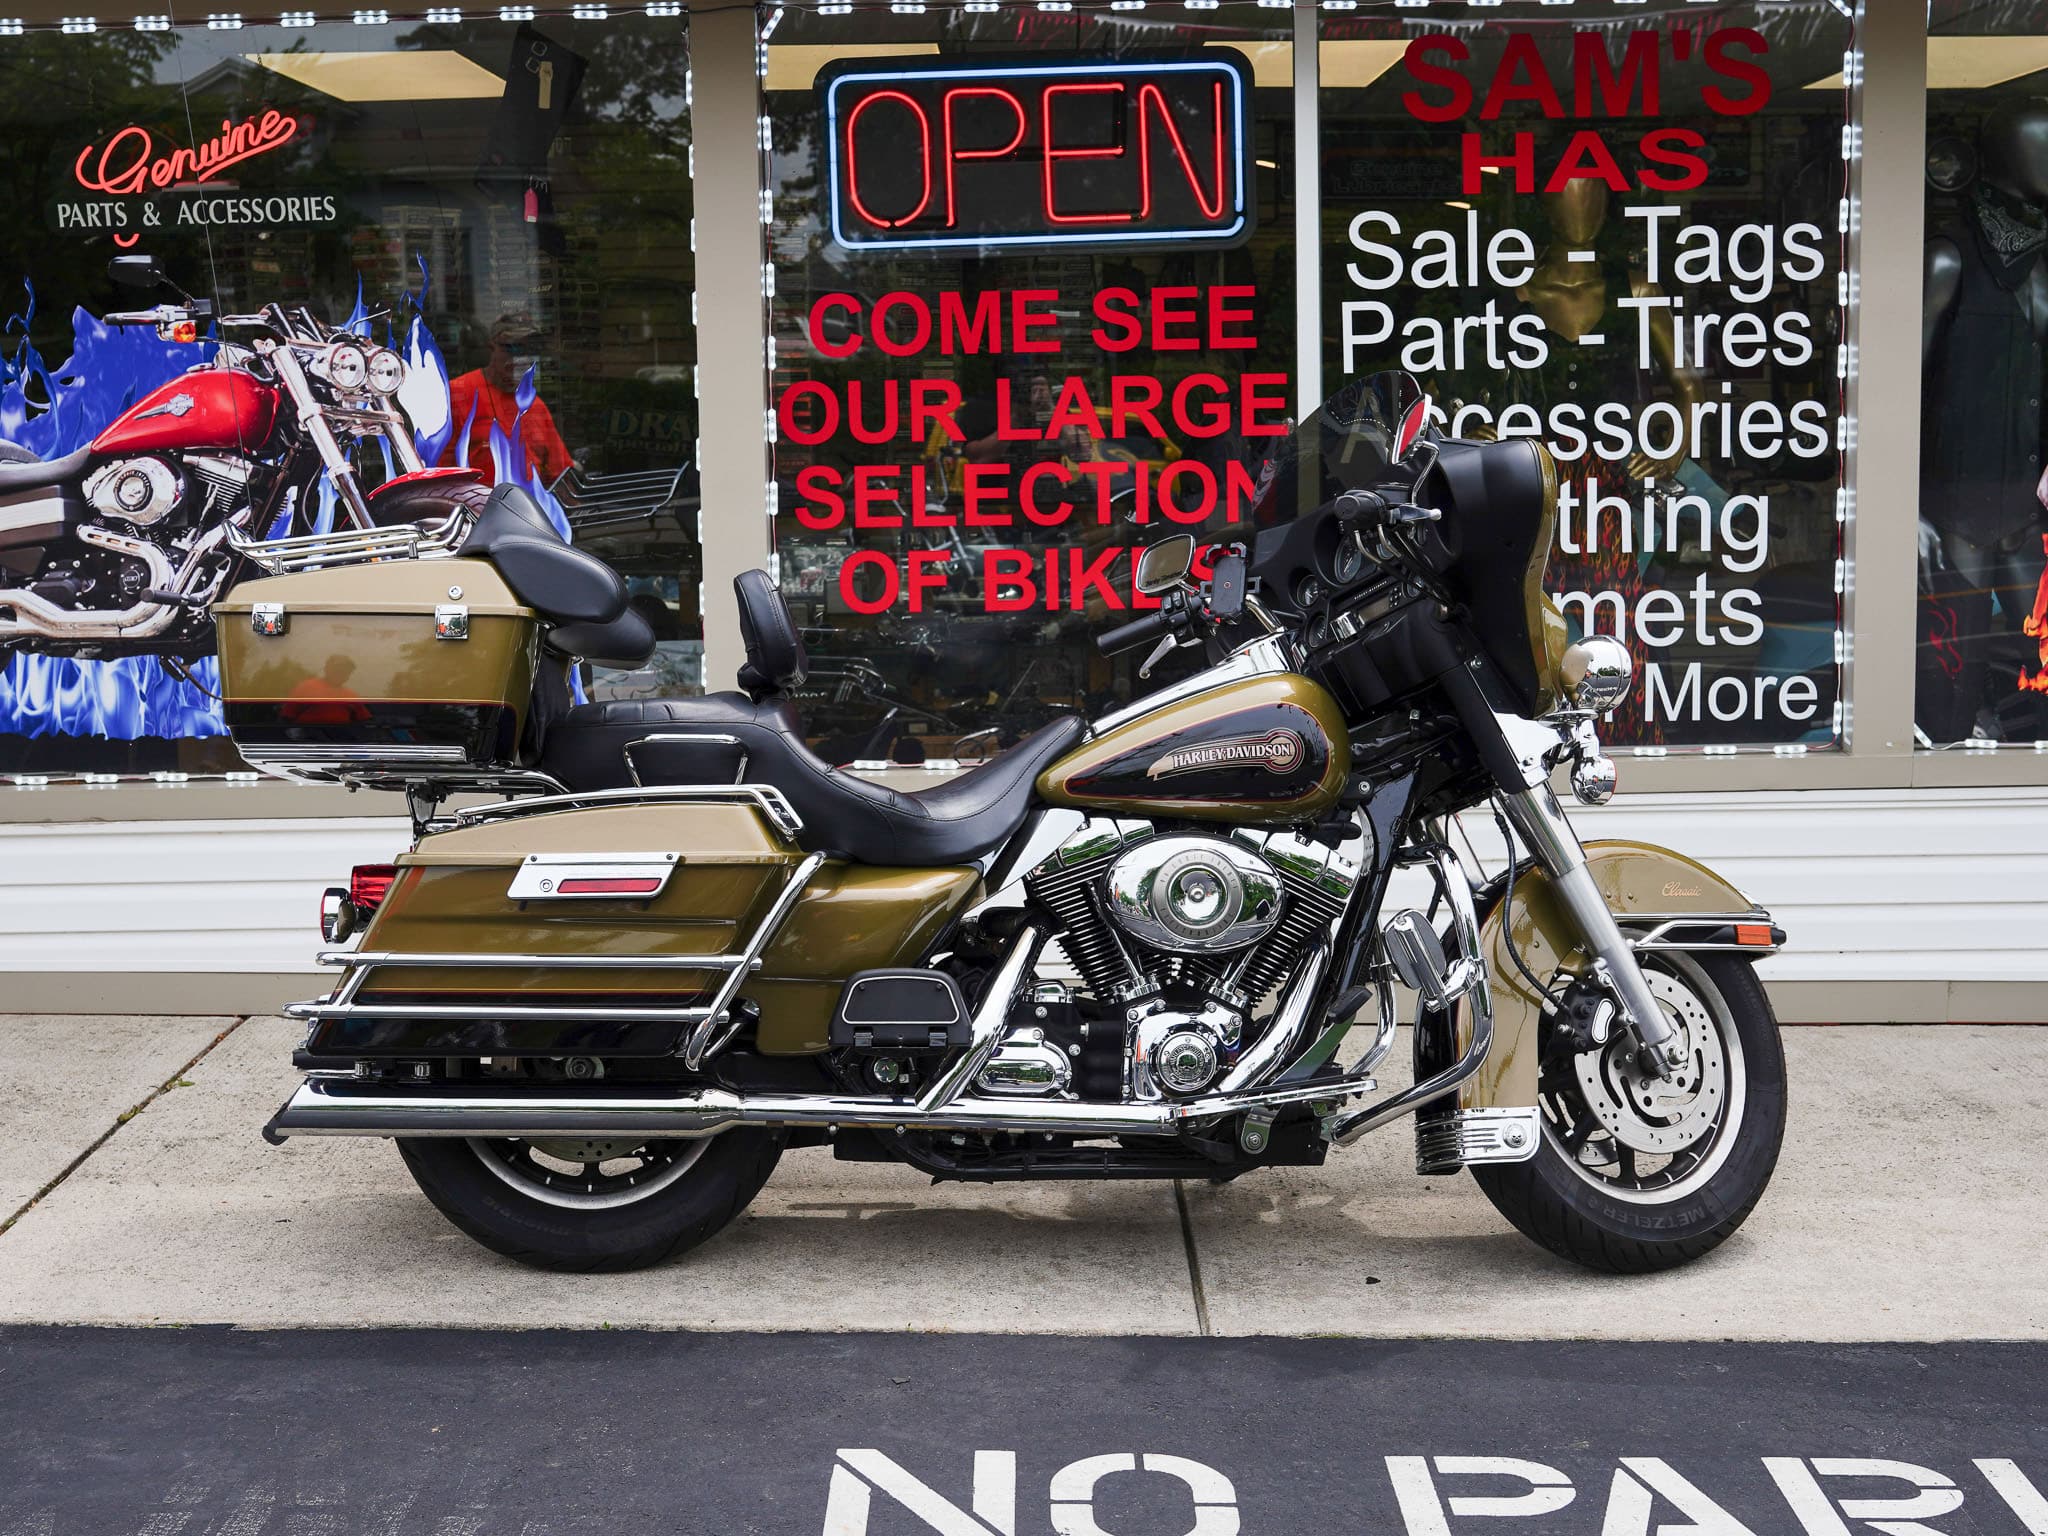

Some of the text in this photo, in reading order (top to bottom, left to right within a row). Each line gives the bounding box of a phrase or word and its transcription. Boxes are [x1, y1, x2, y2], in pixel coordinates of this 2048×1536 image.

[1402, 26, 1772, 123] SAM'S
[75, 109, 297, 193] Genuine
[847, 82, 1224, 228] OPEN
[1462, 128, 1710, 195] HAS
[57, 195, 337, 228] PARTS & ACCESSORIES
[1346, 209, 1535, 290] Sale
[1623, 205, 1826, 303] Tags
[808, 285, 1258, 358] COME SEE
[1341, 299, 1550, 374] Parts
[1617, 296, 1813, 370] Tires
[607, 408, 697, 441] DRA
[778, 372, 1290, 445] OUR LARGE
[1556, 476, 1770, 574] thing
[838, 549, 952, 614] OF
[1551, 571, 1765, 648] mets
[1644, 662, 1819, 723] More
[1602, 1204, 1705, 1230] METZELER
[822, 1448, 1242, 1536] NO
